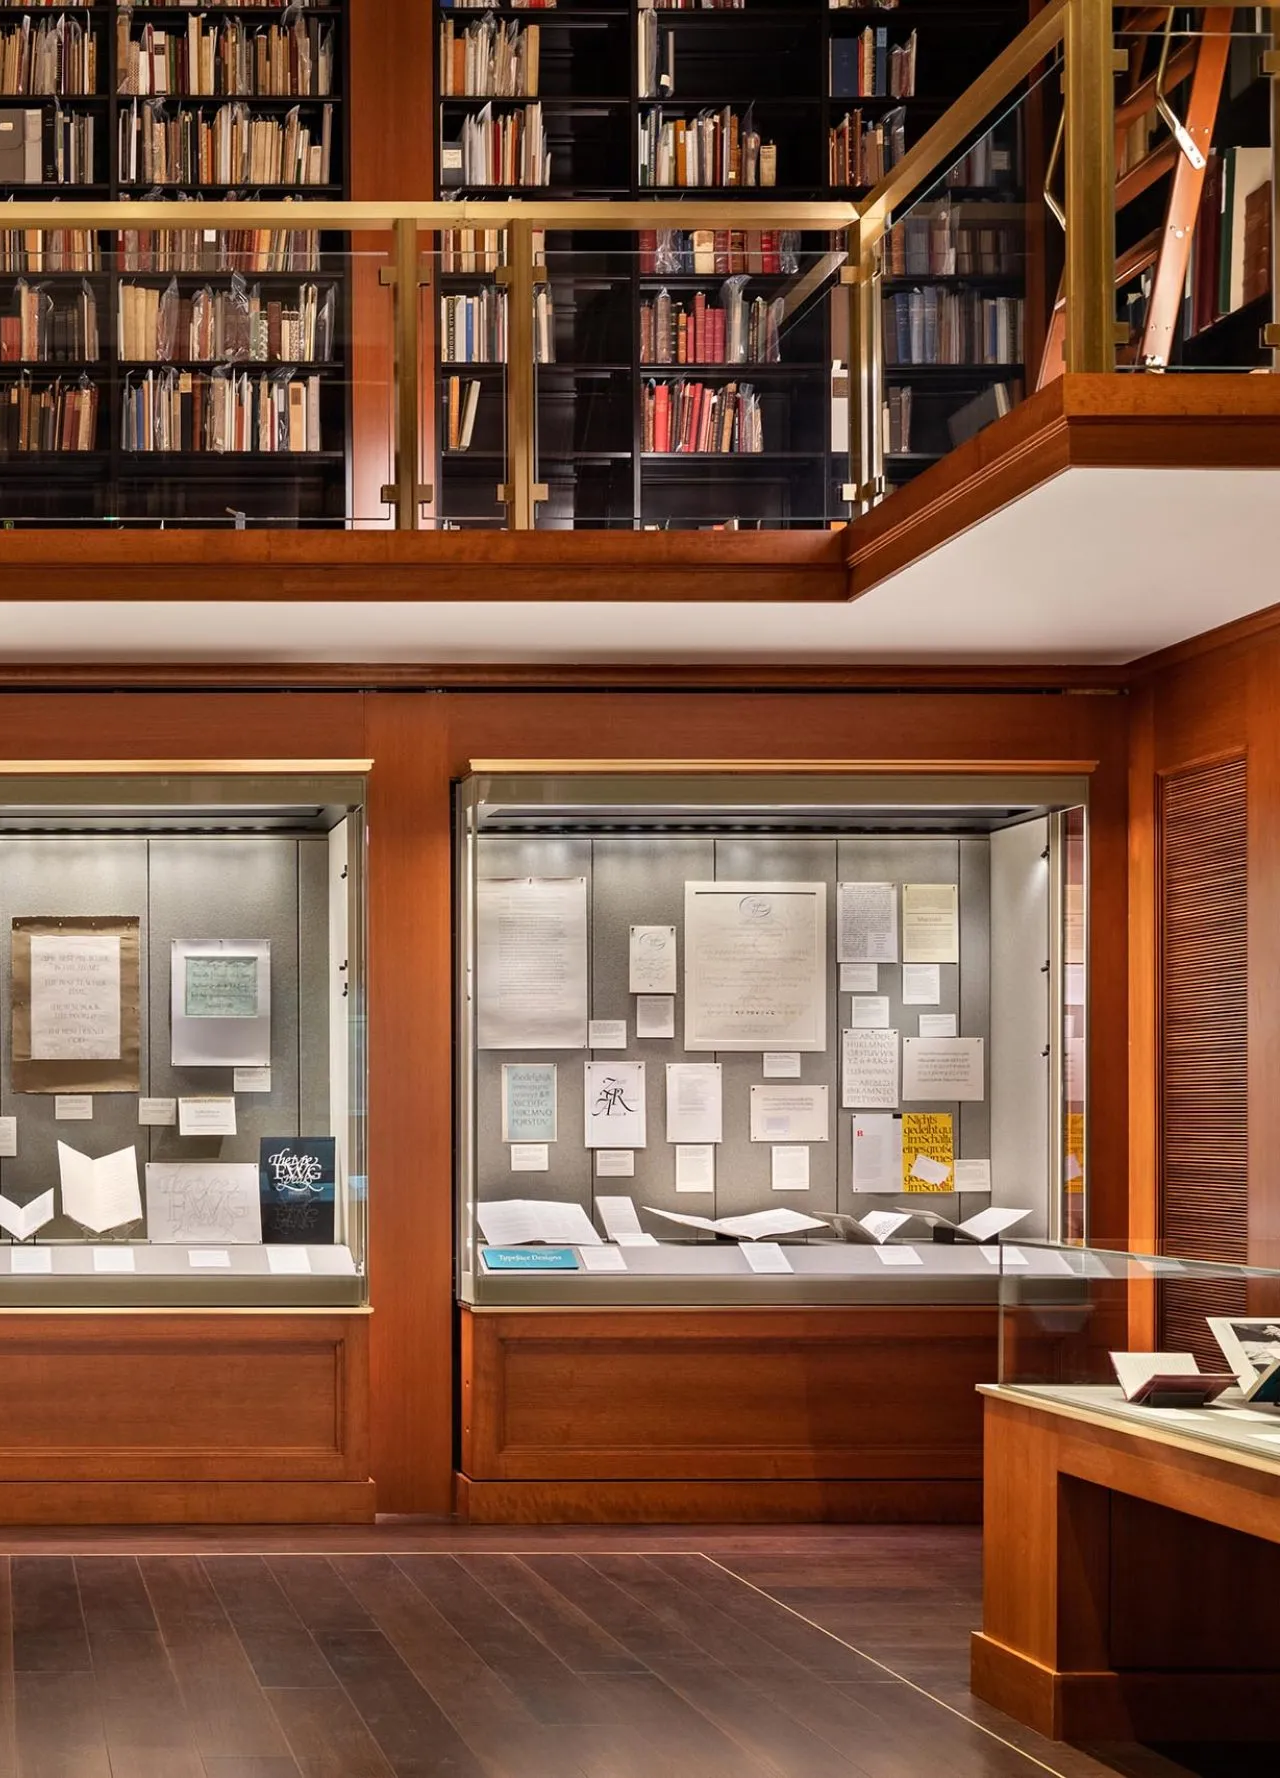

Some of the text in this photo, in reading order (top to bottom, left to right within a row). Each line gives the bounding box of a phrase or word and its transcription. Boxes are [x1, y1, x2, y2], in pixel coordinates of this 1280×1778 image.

[907, 1114, 938, 1125] Nichts
[273, 1163, 322, 1180] EWG
[499, 1253, 562, 1262] Typeface Designs
